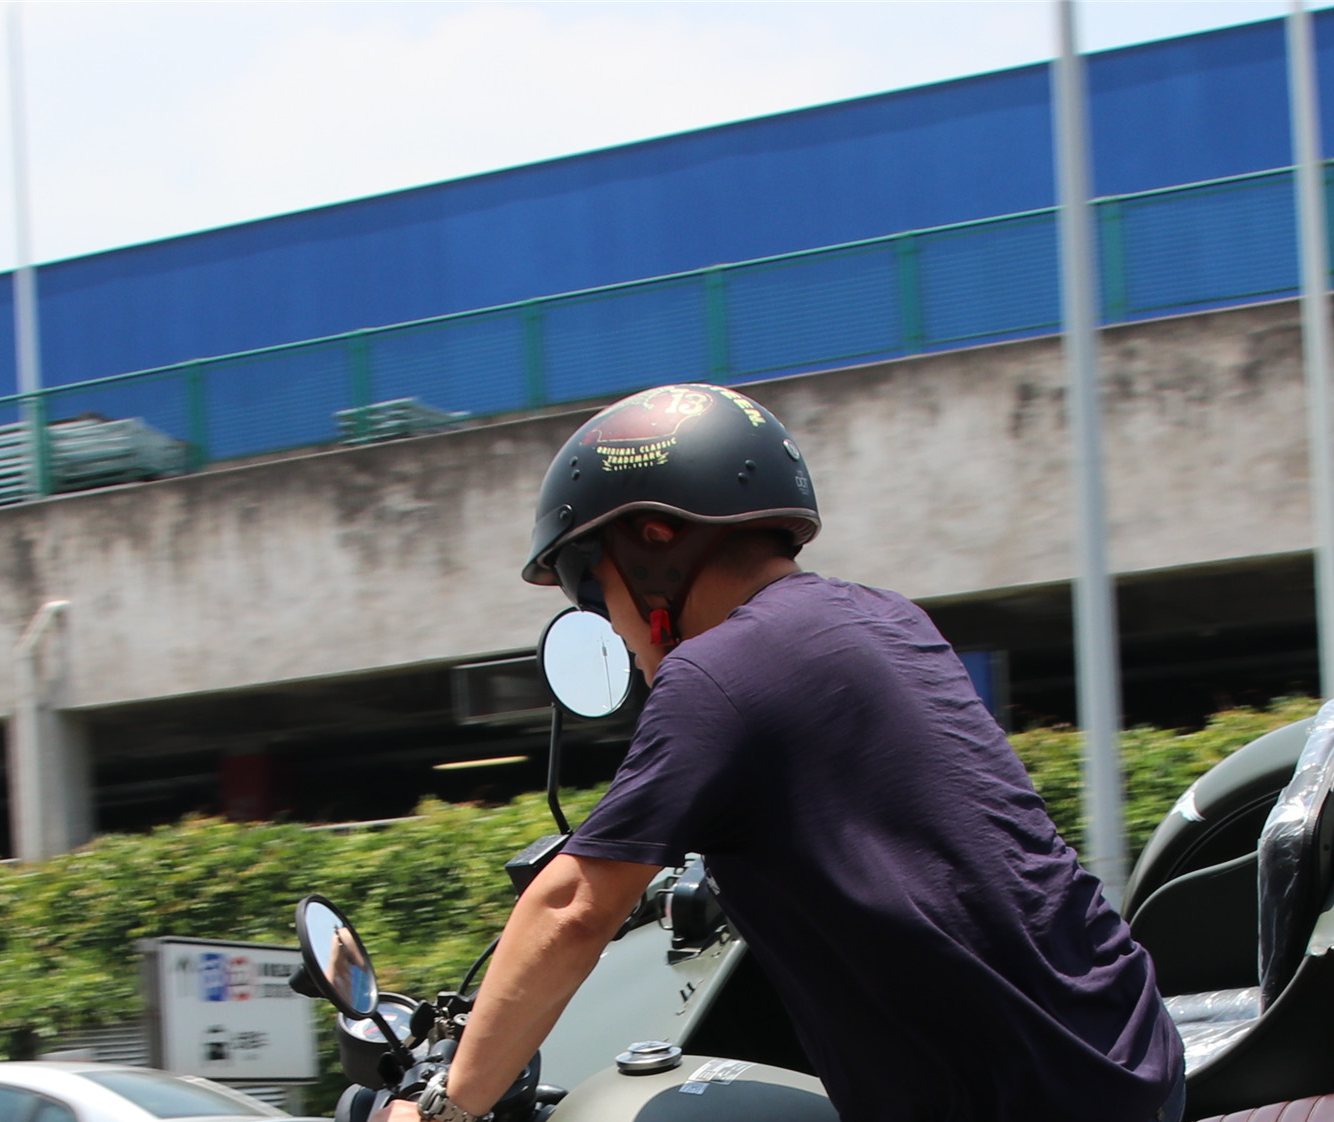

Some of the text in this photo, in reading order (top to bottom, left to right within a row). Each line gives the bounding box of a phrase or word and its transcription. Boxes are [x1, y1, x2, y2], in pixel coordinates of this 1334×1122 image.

[665, 391, 707, 415] 13
[597, 437, 677, 456] ORIGINAL CLASSIC
[608, 450, 663, 464] TRADEMARK
